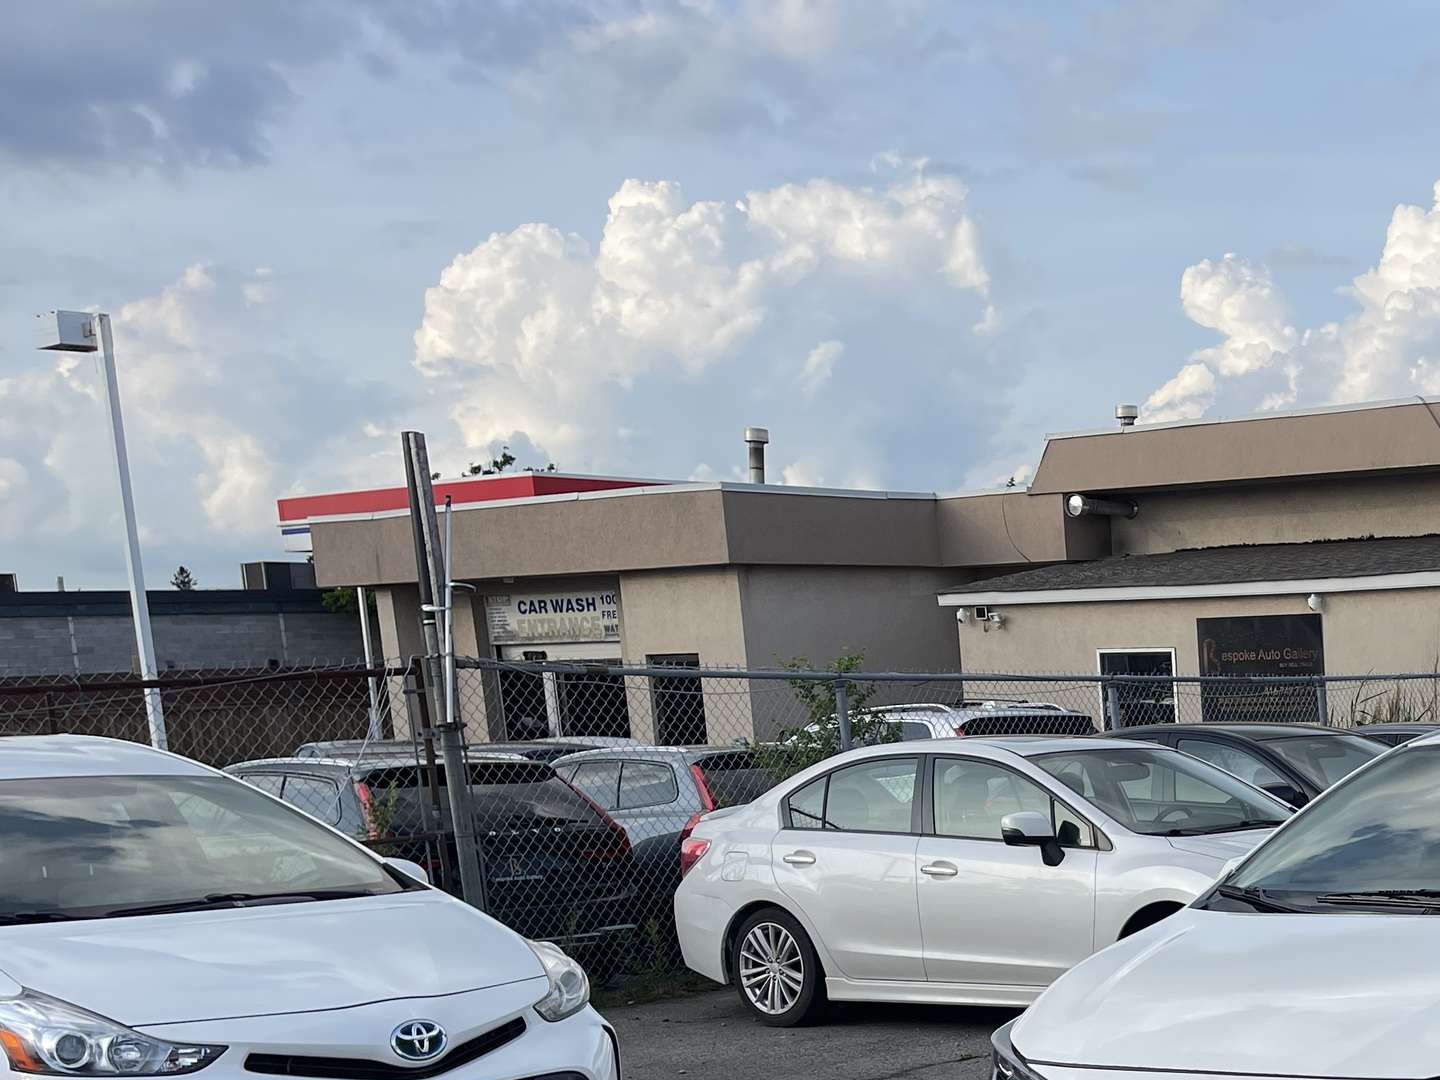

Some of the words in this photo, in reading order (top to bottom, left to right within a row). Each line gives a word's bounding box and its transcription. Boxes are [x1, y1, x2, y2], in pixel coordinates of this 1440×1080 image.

[517, 600, 548, 615] CAR
[550, 597, 597, 613] WASH
[516, 616, 602, 638] ENTRANCE
[1258, 649, 1281, 661] Auto
[1283, 647, 1318, 662] Gallery
